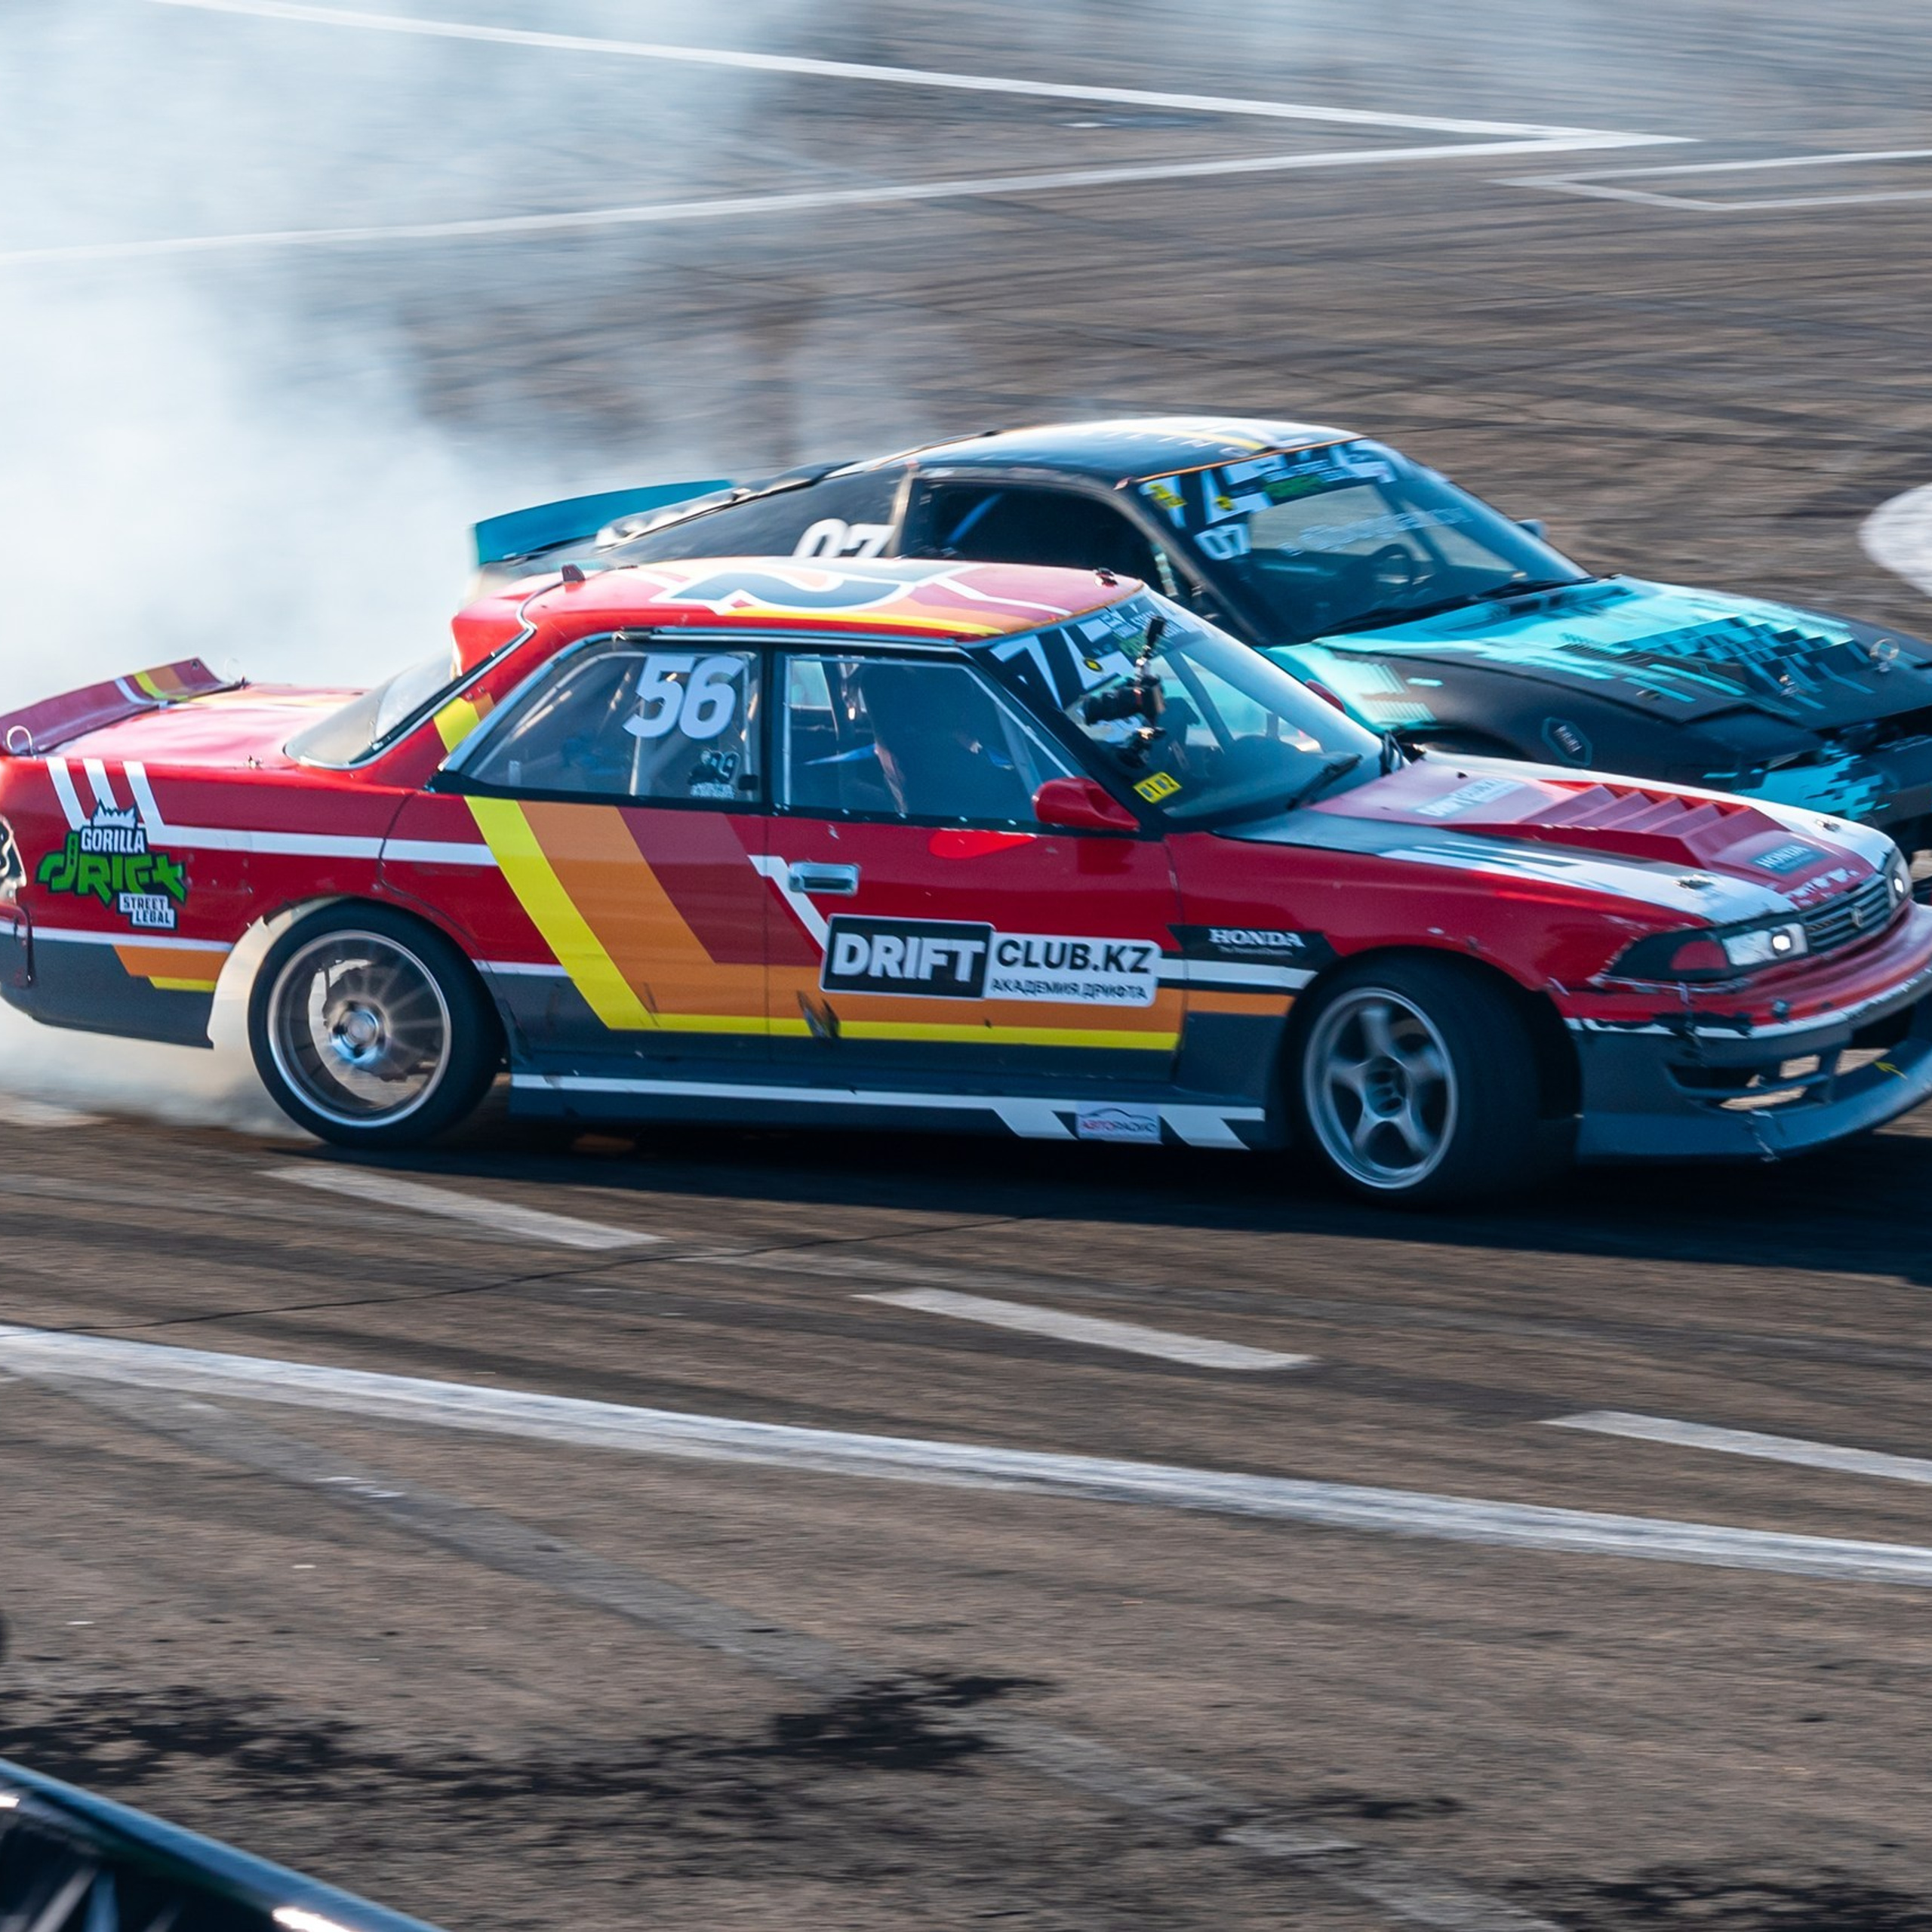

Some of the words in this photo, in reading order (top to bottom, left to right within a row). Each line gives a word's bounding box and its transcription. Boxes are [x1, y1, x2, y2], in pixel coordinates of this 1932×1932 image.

[1194, 523, 1251, 560] 07
[623, 654, 744, 740] 56
[81, 828, 146, 854] GORILLA
[123, 894, 167, 910] STREET
[135, 909, 171, 925] LEGAL
[1208, 928, 1306, 948] HONDA
[832, 932, 986, 983] DRIFT
[997, 939, 1152, 974] CLUB.KZ
[992, 978, 1080, 996] АКАДЕМИЯ
[1080, 982, 1148, 1000] ДРИФТА
